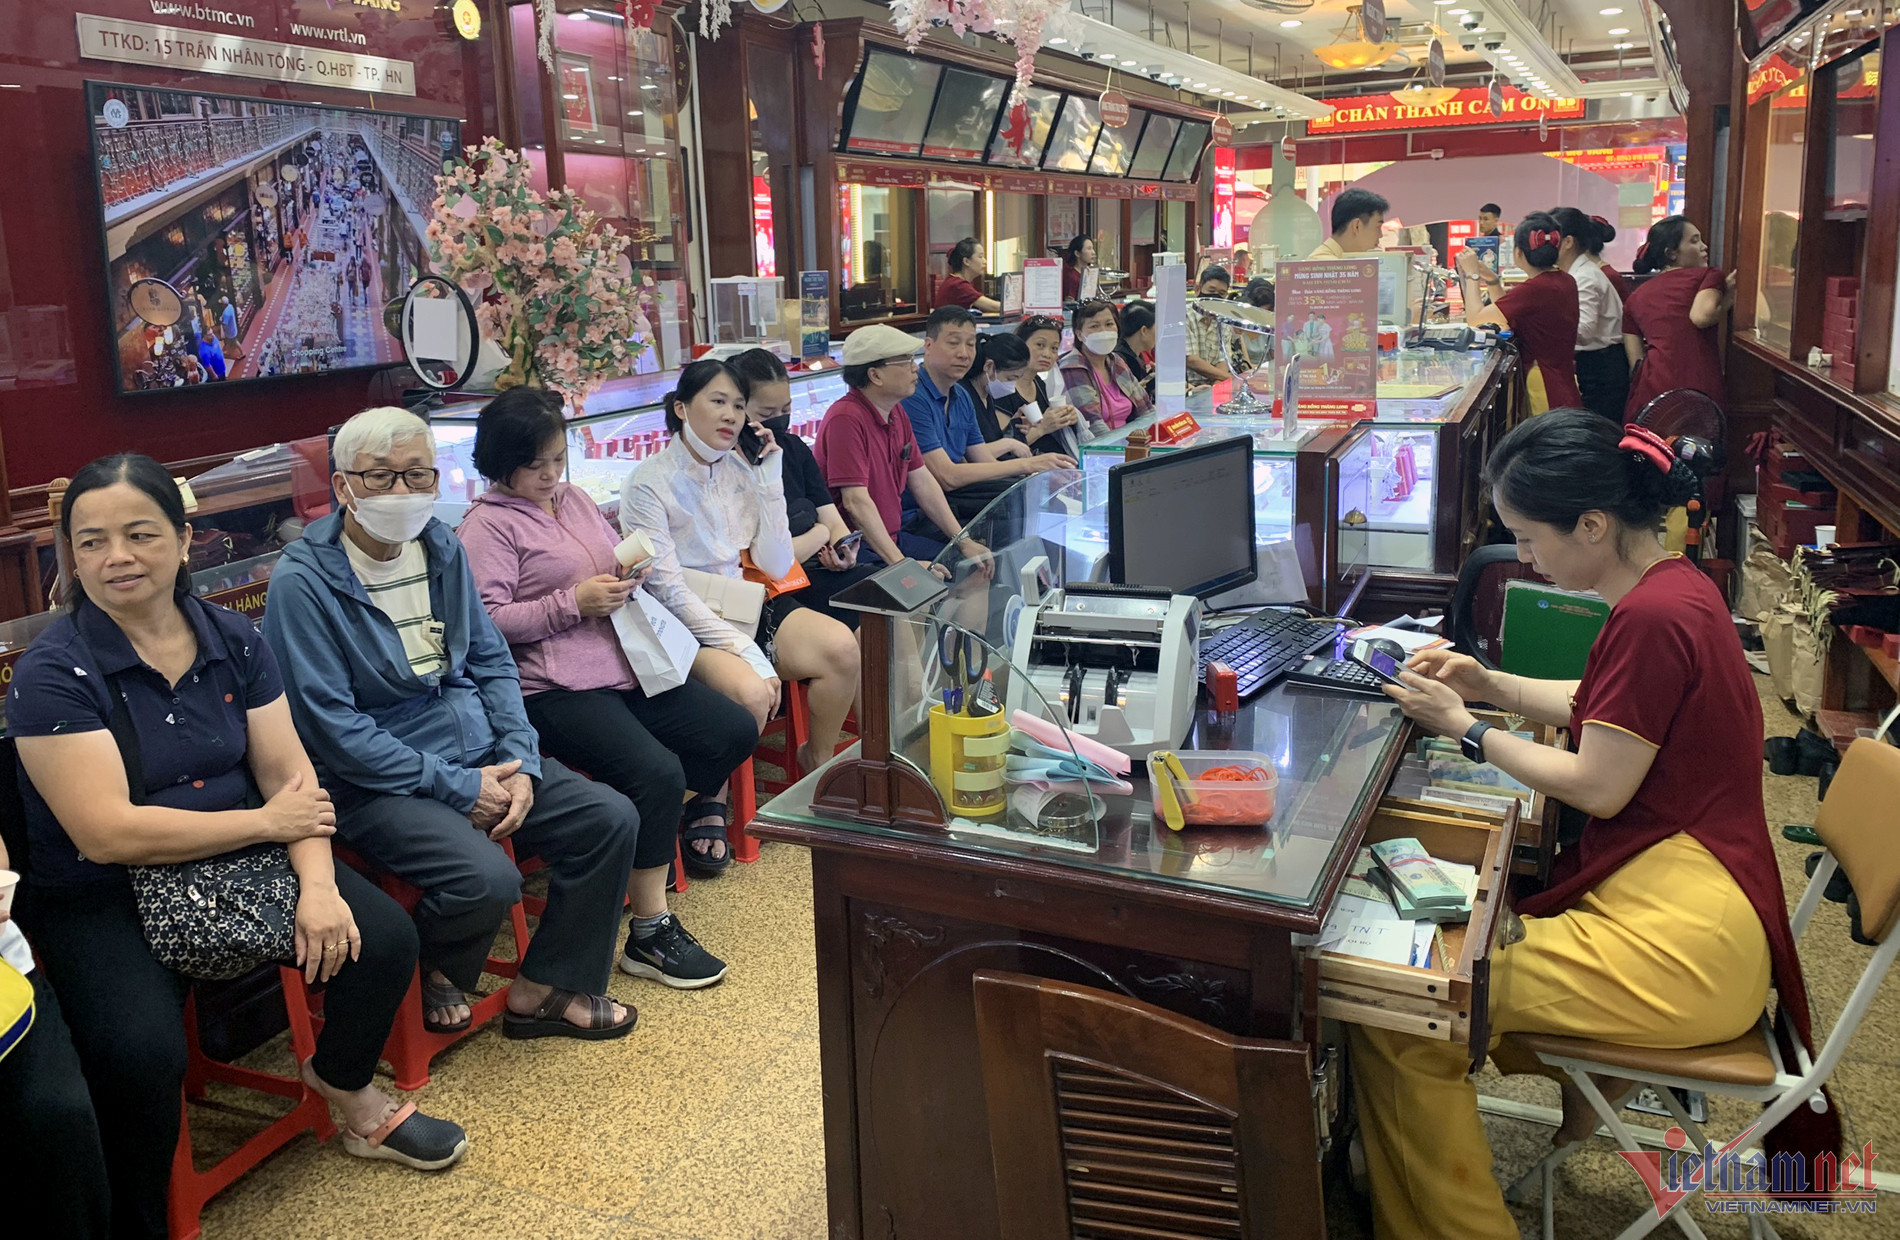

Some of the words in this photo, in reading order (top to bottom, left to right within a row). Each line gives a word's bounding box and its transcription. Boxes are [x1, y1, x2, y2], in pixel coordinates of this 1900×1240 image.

[151, 1, 255, 28] www.btmc.vn
[290, 22, 366, 45] www.vrtl.vn
[98, 30, 149, 52] TTKD:
[154, 38, 172, 55] 15
[222, 47, 264, 66] NHÂN
[267, 51, 306, 72] TÔNG
[317, 60, 354, 77] Q.HBT
[363, 66, 380, 81] TP.
[385, 69, 403, 84] HN
[675, 45, 681, 53] 2
[1335, 104, 1388, 124] CHÂN
[1303, 295, 1326, 305] 35%
[291, 347, 324, 357] Shopping
[235, 591, 268, 613] HÀNG
